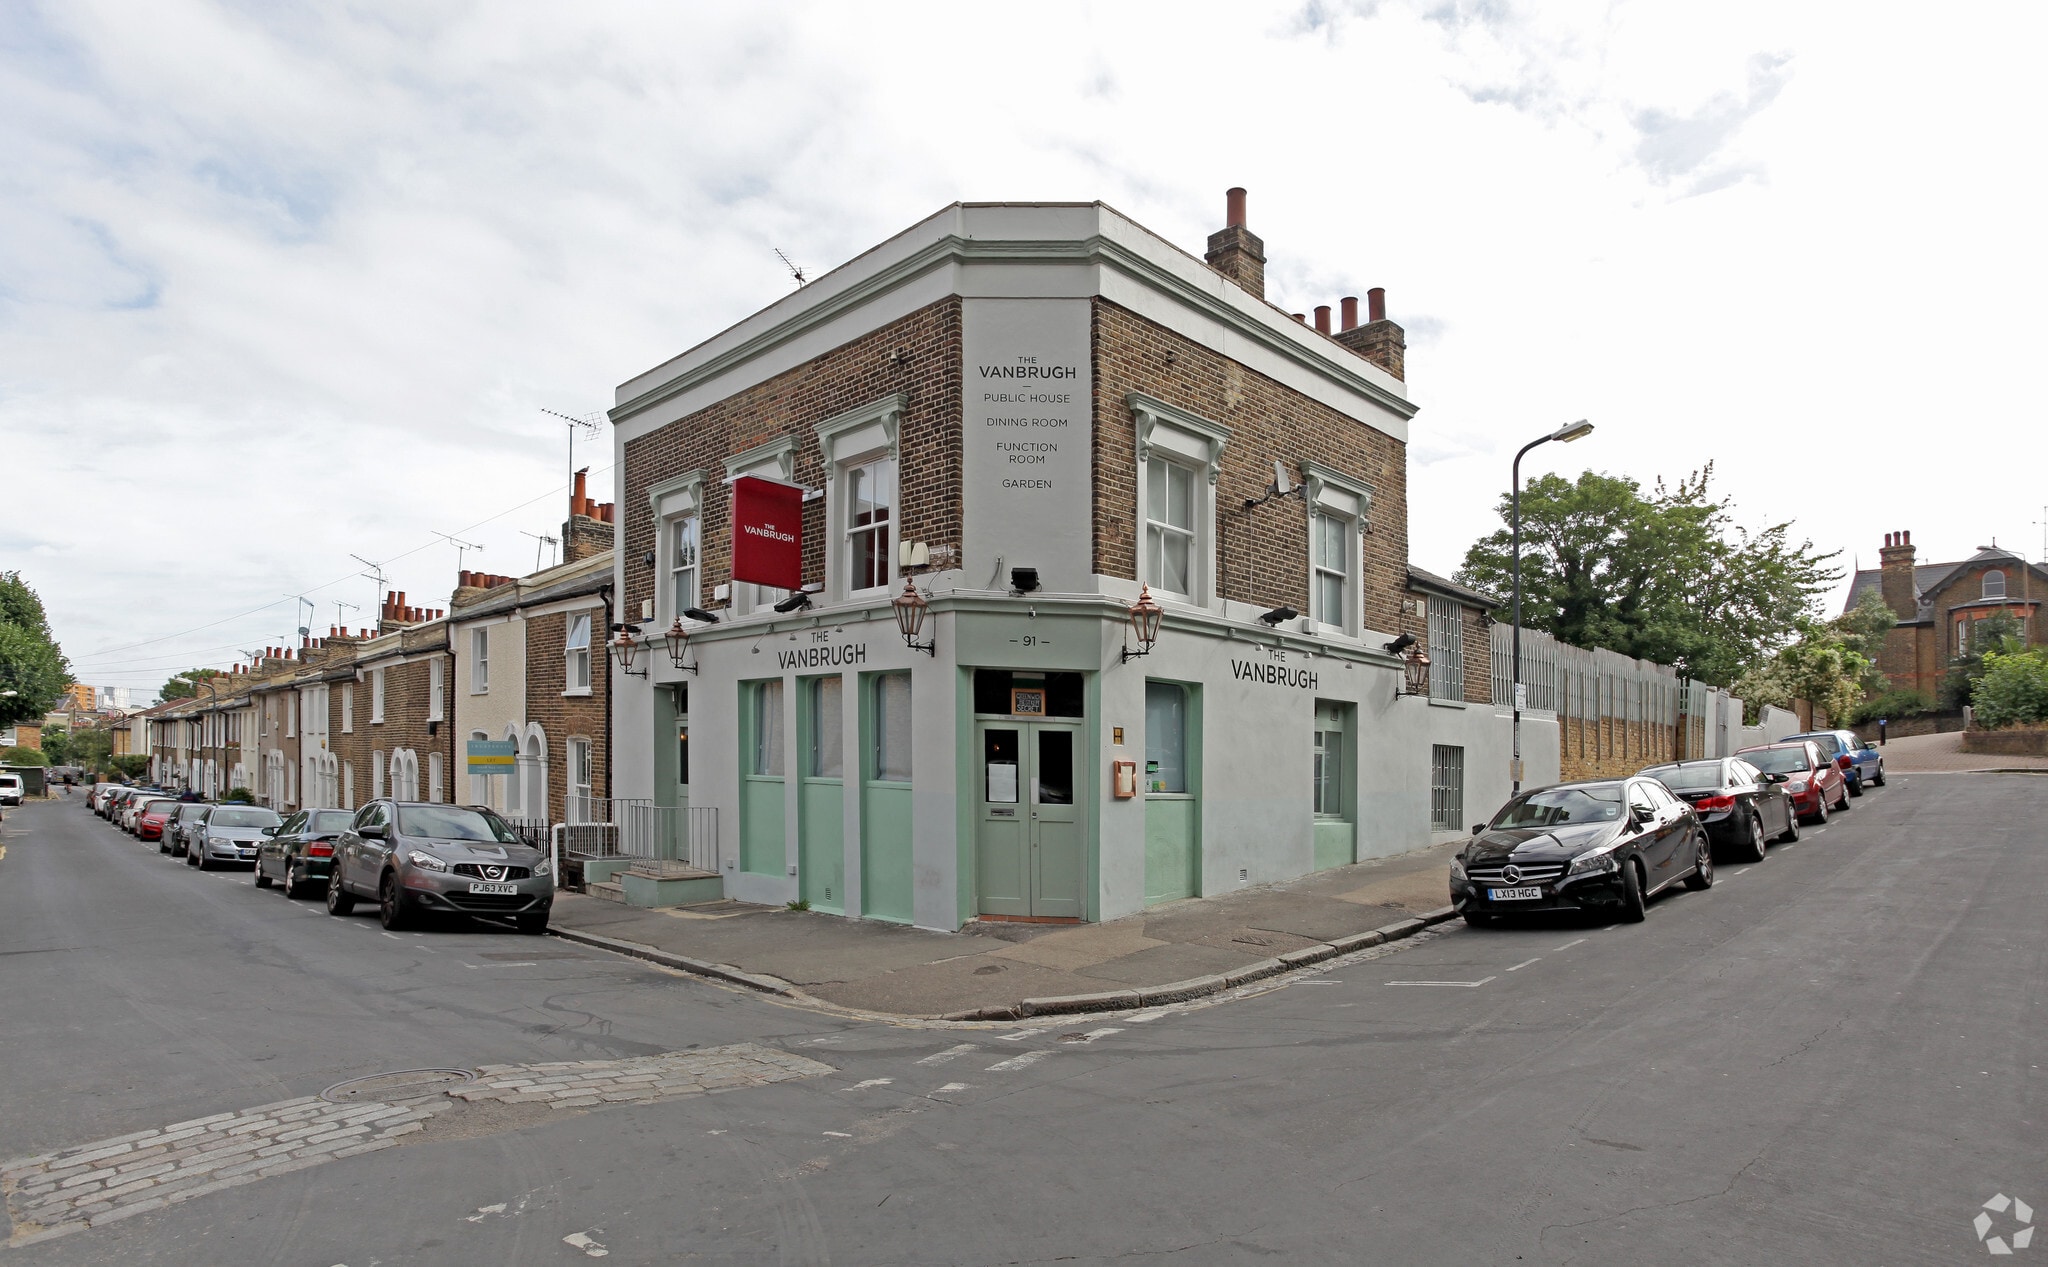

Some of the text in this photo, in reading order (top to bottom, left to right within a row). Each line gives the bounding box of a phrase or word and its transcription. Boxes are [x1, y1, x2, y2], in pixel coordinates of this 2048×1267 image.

[1018, 356, 1037, 364] THE
[979, 365, 1076, 379] VANBRUGH
[984, 393, 1071, 403] PUBLIC HOUSE
[986, 417, 1068, 428] DINING ROOM
[996, 442, 1058, 452] FUNCTION
[1009, 455, 1045, 464] ROOM
[1002, 479, 1052, 489] GARDEN
[764, 523, 775, 531] THE
[744, 525, 795, 543] VANBRUGH
[811, 630, 829, 644] THE
[1022, 635, 1037, 647] 91
[778, 643, 866, 670] VANBRUGH
[1268, 649, 1286, 663] THE
[1231, 658, 1318, 691] VANBRUGH
[473, 884, 514, 893] PJ63 XVC
[1495, 888, 1538, 899] LX13 HGC
